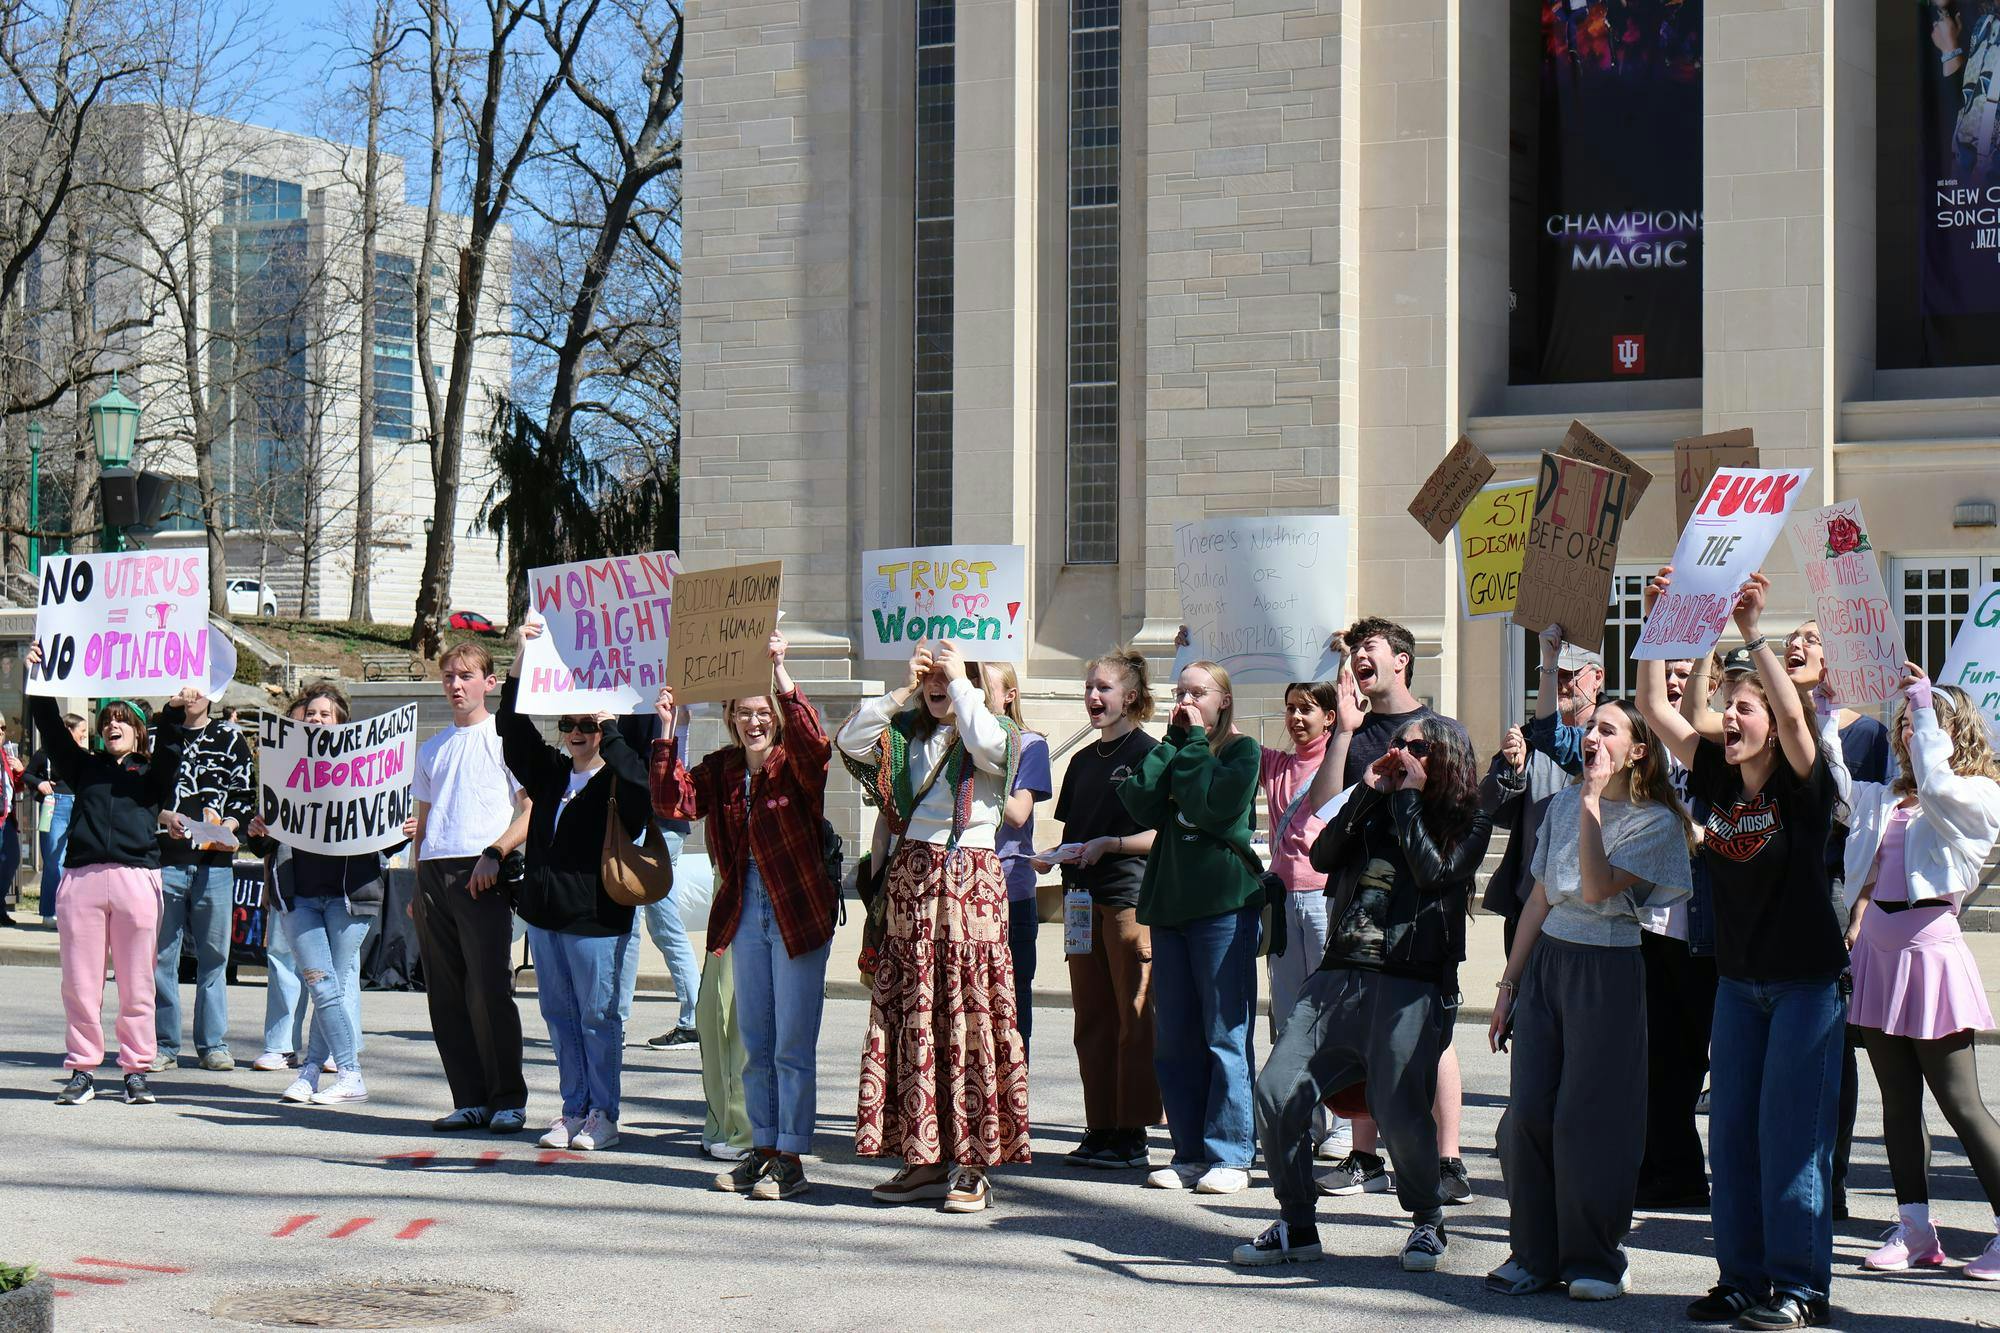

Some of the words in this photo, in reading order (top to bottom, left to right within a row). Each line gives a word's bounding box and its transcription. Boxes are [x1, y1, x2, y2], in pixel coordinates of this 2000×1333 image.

[1937, 187, 1980, 207] NEW
[1546, 210, 1703, 237] CHAMPION
[1937, 208, 2000, 228] SONG
[1976, 228, 1996, 249] JAZZ
[1572, 241, 1688, 271] MAGIC
[1583, 432, 1606, 453] MAKE
[1610, 450, 1632, 474] YOUR
[1425, 465, 1449, 497] STOP
[1534, 453, 1628, 543] DEATH
[1696, 474, 1800, 517] FUCK
[1439, 472, 1483, 525] Overreach
[1176, 522, 1240, 557] There's
[1251, 524, 1320, 568] Nothing
[1529, 518, 1614, 572] BEFORE
[1696, 535, 1742, 567] THE
[1794, 524, 1826, 557] WE
[41, 557, 94, 606] NO
[105, 556, 200, 598] UTERUS
[878, 559, 997, 592] TRUST
[1177, 562, 1229, 595] Radical
[1253, 568, 1282, 582] OR
[1833, 554, 1869, 585] THE
[725, 573, 780, 608] AUTONOMY
[1253, 593, 1300, 612] About
[1470, 571, 1521, 605] GOVE
[677, 622, 695, 649] IS
[701, 622, 712, 645] A
[719, 616, 765, 643] HUMAN
[1817, 596, 1889, 636] RIGHT
[30, 633, 76, 681] NO
[84, 628, 208, 680] OPINION
[1193, 620, 1319, 657] TRANSPHOBIA
[1845, 640, 1868, 663] BE
[590, 645, 635, 671] ARE
[683, 650, 744, 687] RIGHT!
[531, 666, 631, 693] HUMAN
[1825, 664, 1902, 704] HEARD
[262, 711, 294, 749] IF
[304, 725, 362, 758] YOU'RE
[366, 705, 417, 748] AGAINST
[286, 741, 405, 792] ABORTION
[263, 784, 322, 839] DON'T
[323, 790, 386, 843] HAVE
[388, 784, 412, 829] ONE
[232, 907, 267, 948] CA
